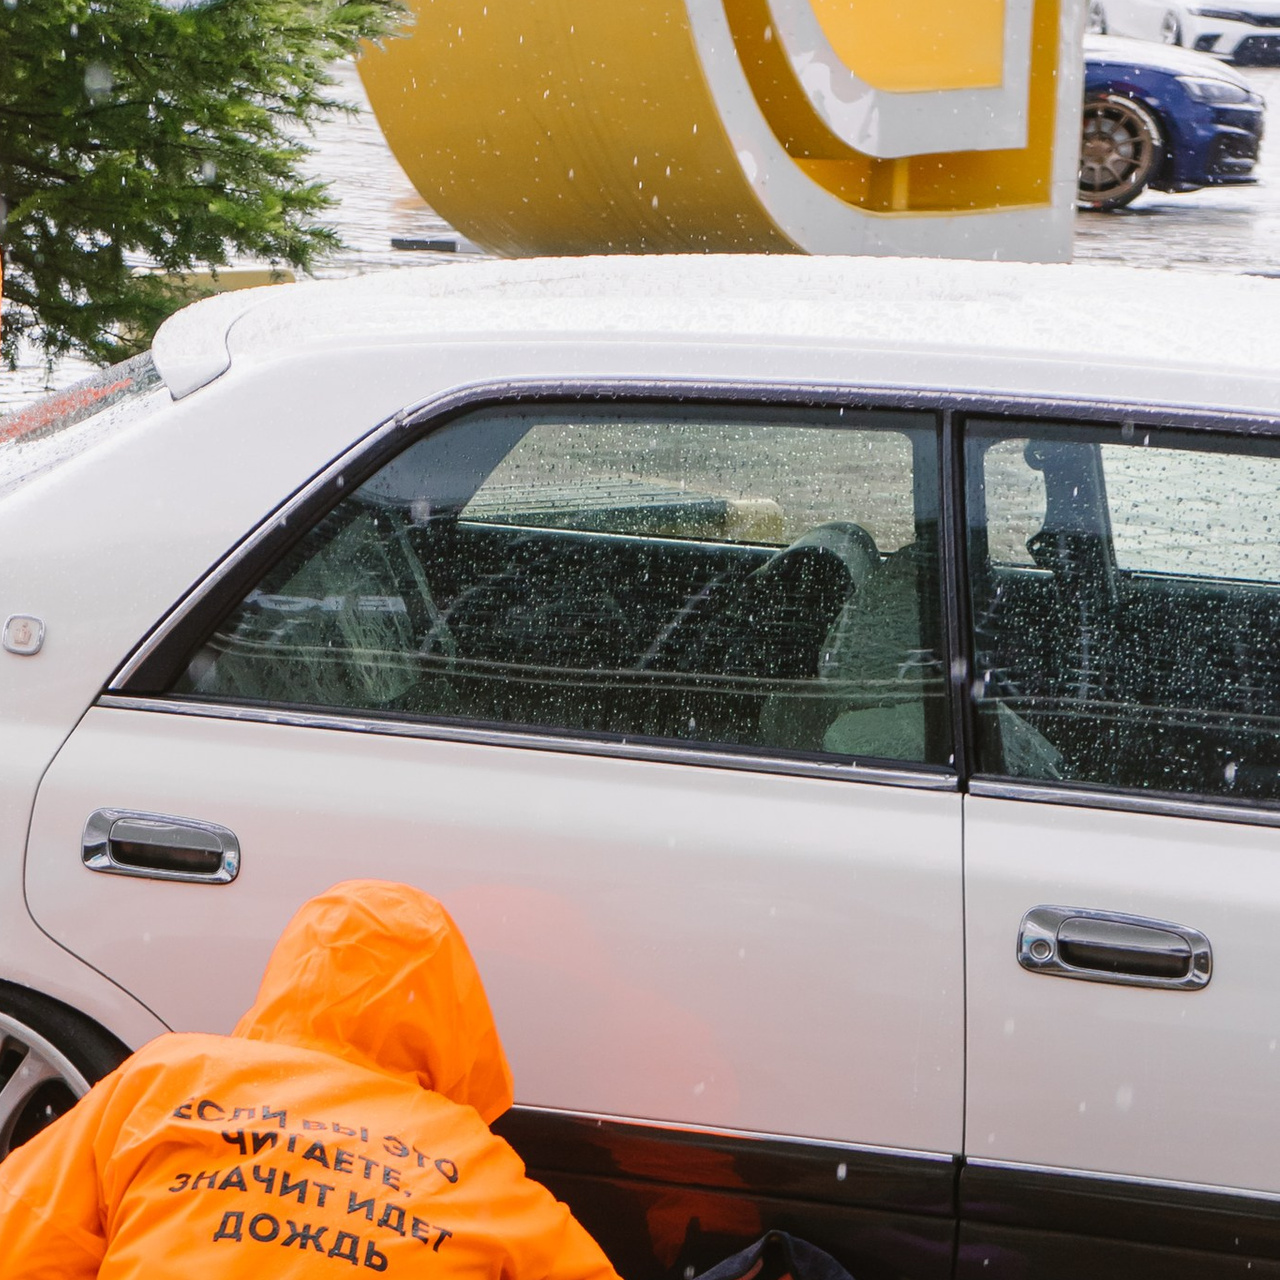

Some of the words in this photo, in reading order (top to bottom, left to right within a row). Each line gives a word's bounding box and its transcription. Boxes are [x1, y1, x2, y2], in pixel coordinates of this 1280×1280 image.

[172, 1097, 288, 1129] ЕСЛИ
[382, 1134, 460, 1185] ЭТО
[168, 1164, 336, 1208] ЗНАЧИТ
[347, 1190, 454, 1254] ИДЕТ
[212, 1211, 389, 1274] ДОЖДЬ
